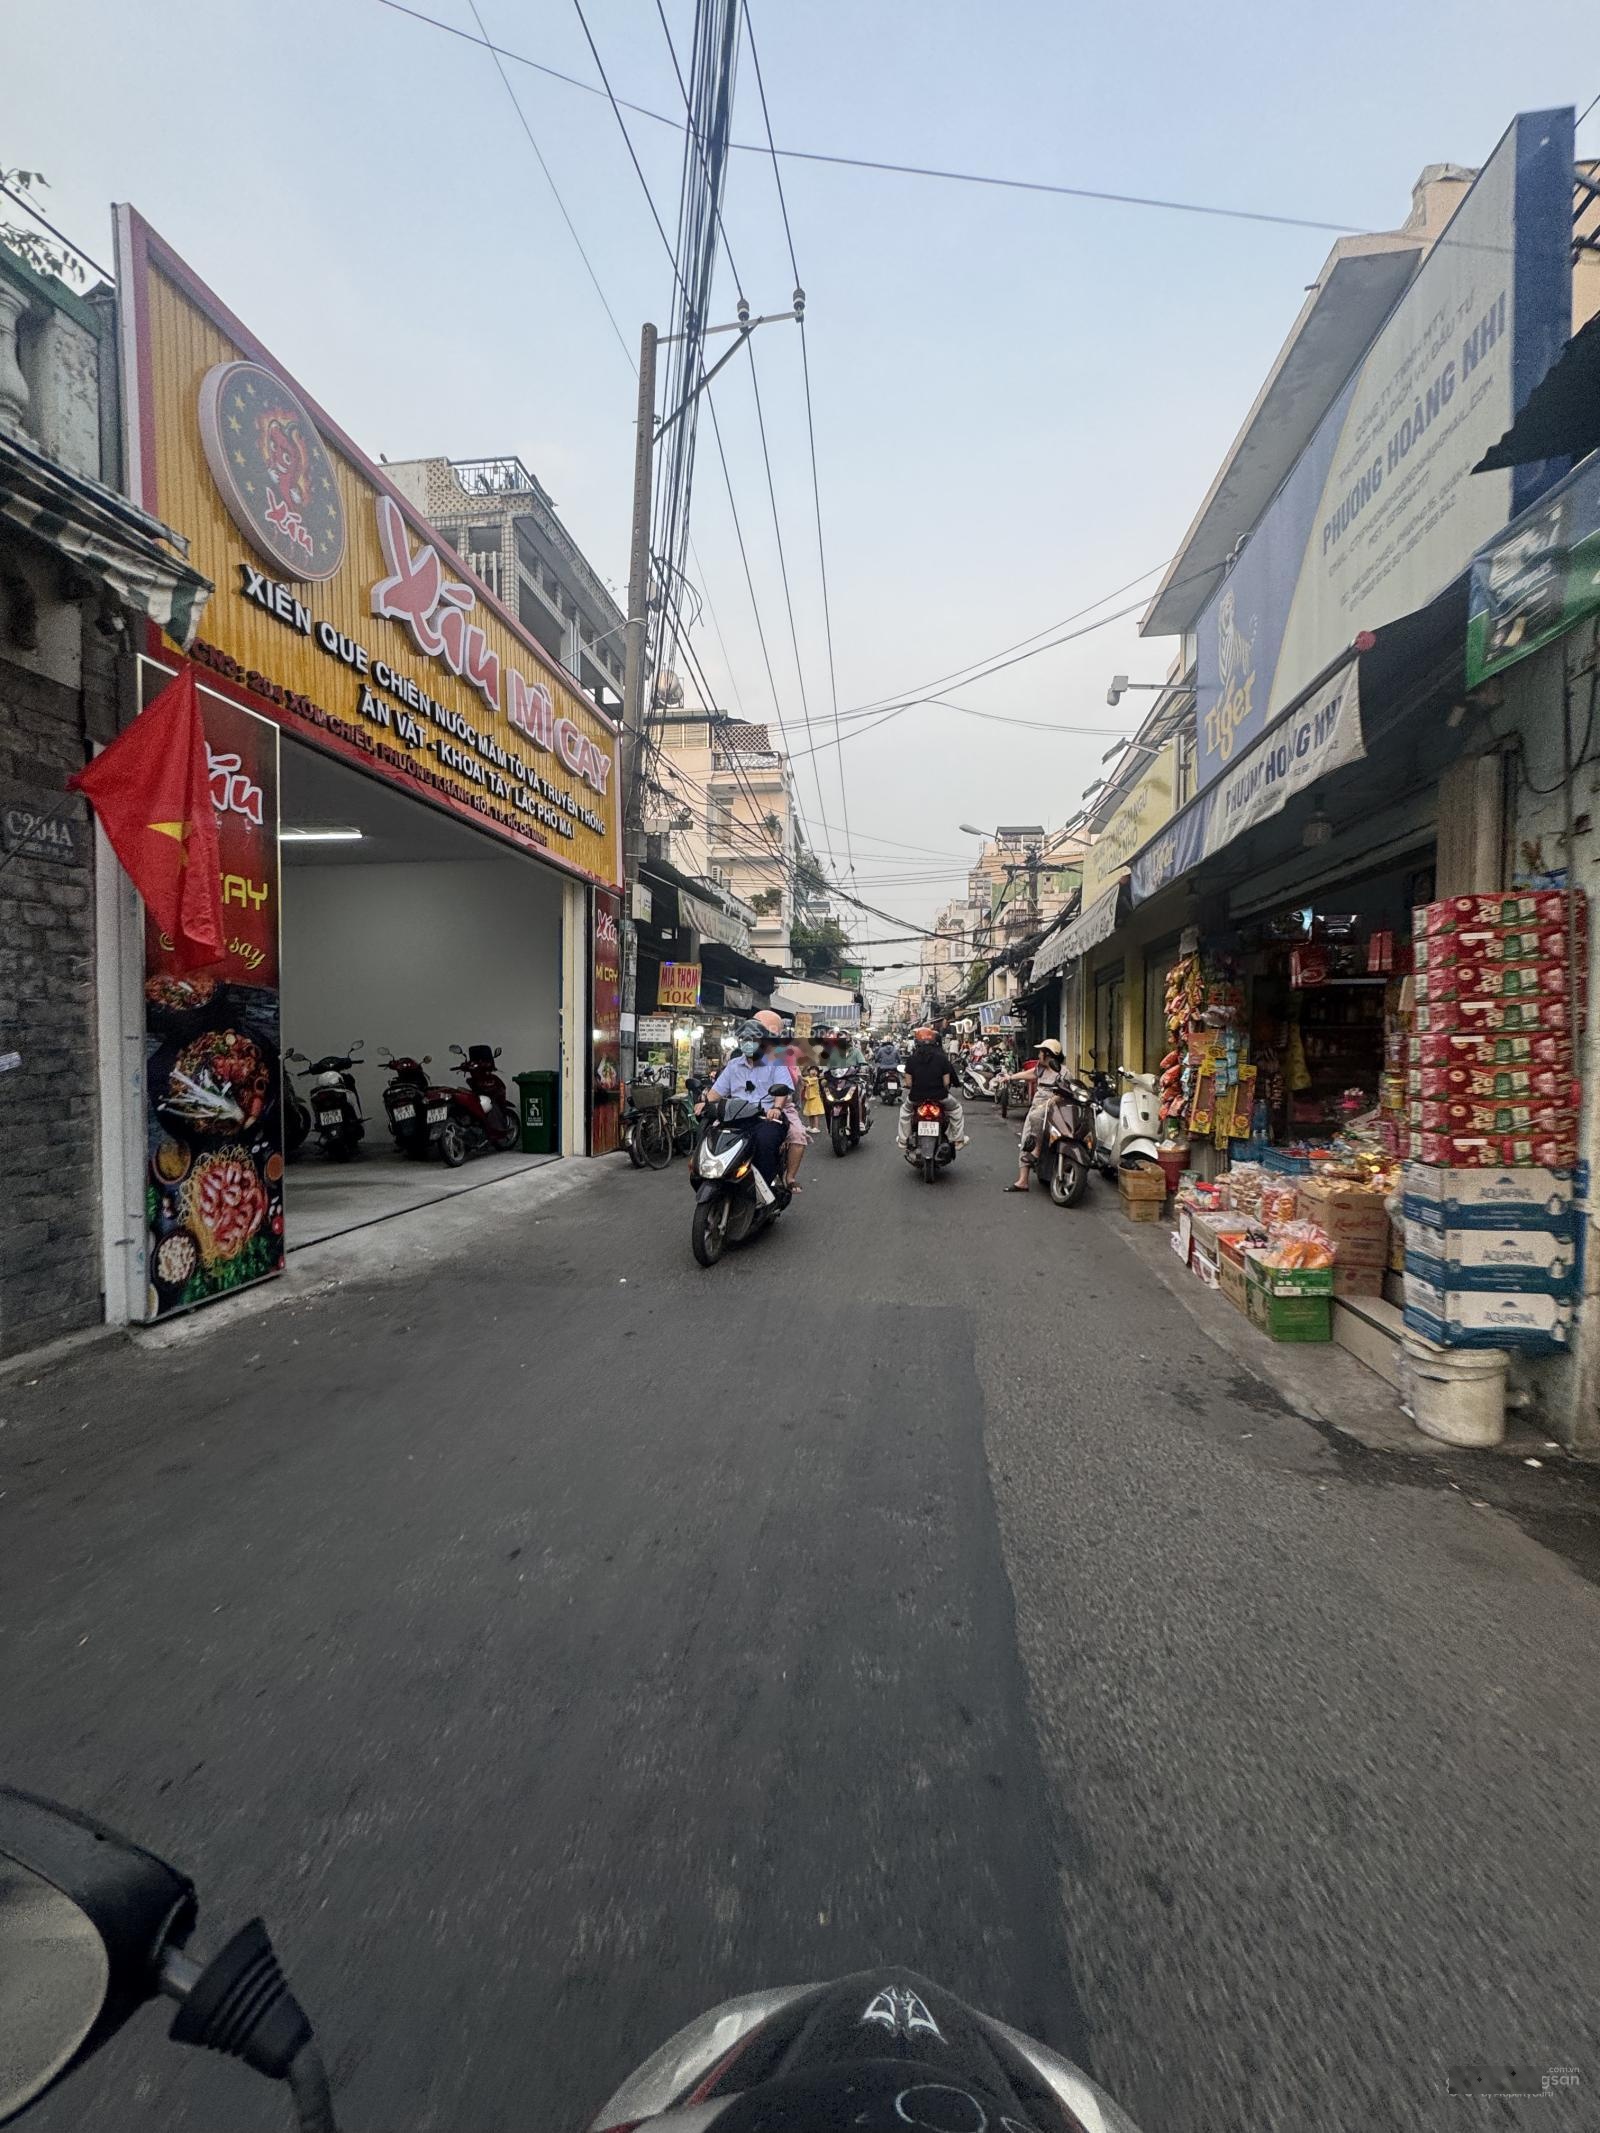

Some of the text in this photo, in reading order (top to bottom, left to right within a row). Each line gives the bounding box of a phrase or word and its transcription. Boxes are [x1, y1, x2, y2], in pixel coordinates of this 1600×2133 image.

[1387, 360, 1456, 476] HOÀNG
[1462, 290, 1506, 384] NHI
[242, 564, 312, 635] XIÊN
[317, 621, 369, 674] QUE
[373, 661, 431, 716] CHIÊN
[1205, 670, 1256, 761] Tiger
[359, 684, 390, 728] ĂN
[394, 710, 427, 750] VẶT
[439, 740, 486, 785] KHOAI
[487, 772, 512, 799] TÂY
[559, 817, 575, 839] MAI
[554, 718, 612, 796] CAY
[222, 873, 268, 911] AY
[604, 968, 618, 982] CAY
[663, 991, 694, 1005] 10K
[1480, 1187, 1531, 1199] AQUAFINA
[1482, 1250, 1536, 1263] AQUAFINA
[1483, 1311, 1538, 1326] AQUAFINA
